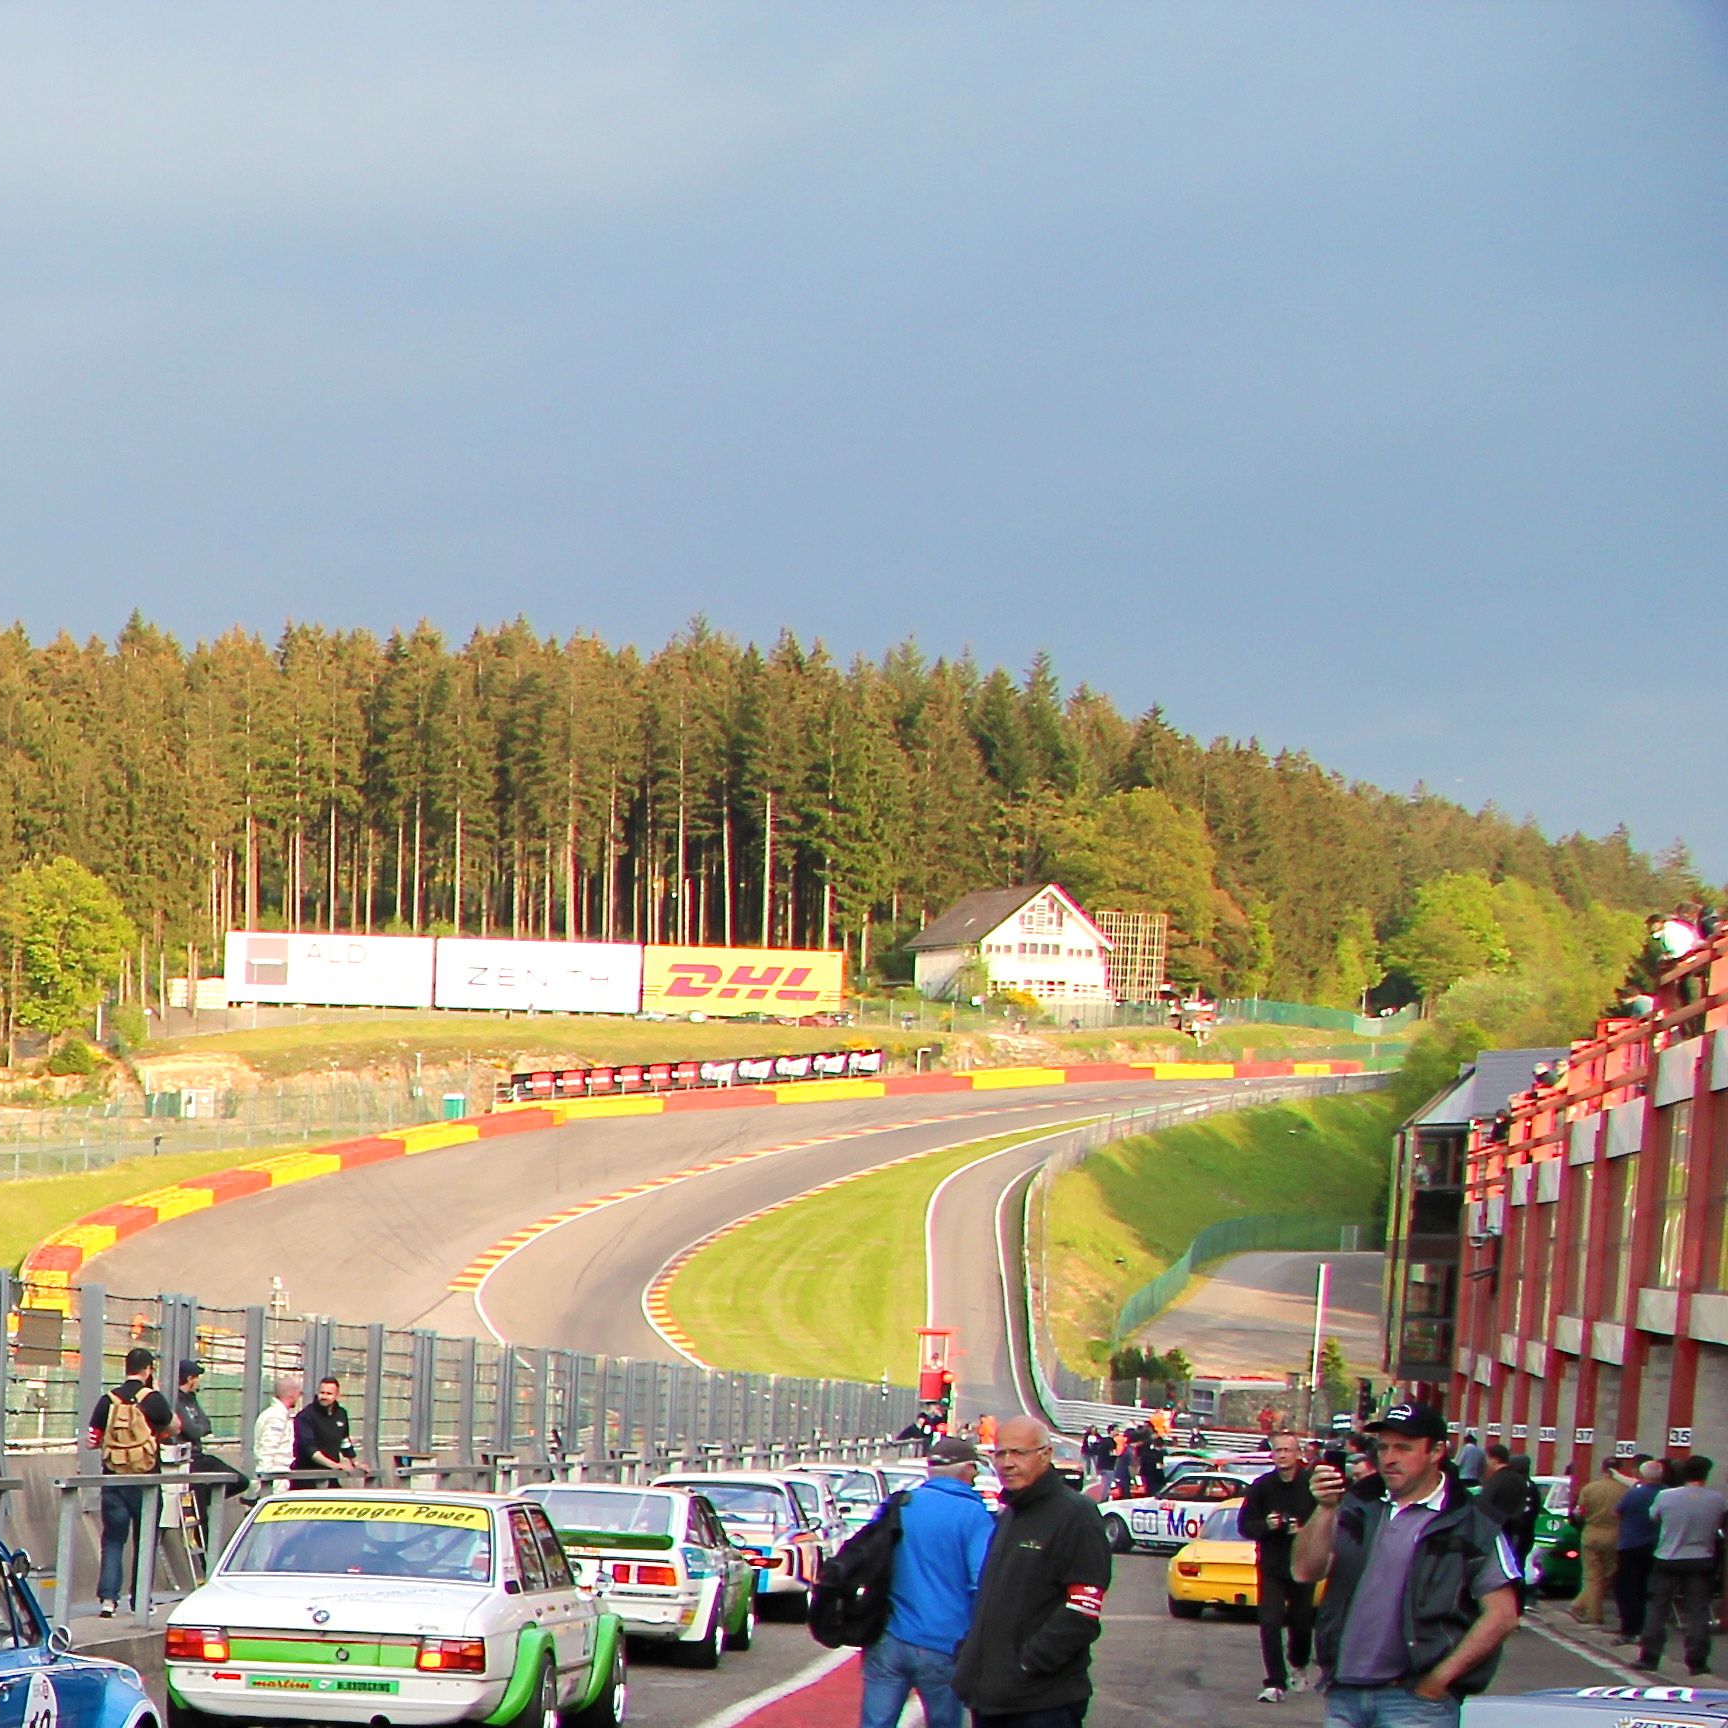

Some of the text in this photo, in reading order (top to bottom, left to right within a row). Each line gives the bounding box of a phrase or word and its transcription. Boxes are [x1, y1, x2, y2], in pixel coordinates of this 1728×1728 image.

[305, 943, 367, 964] ALD
[467, 966, 609, 987] ZENTH
[664, 963, 820, 1001] DHL
[1513, 1425, 1527, 1437] 39
[1541, 1428, 1556, 1440] 38
[1576, 1430, 1593, 1441] 37
[1670, 1429, 1690, 1443] 35
[1617, 1443, 1634, 1456] 36
[272, 1503, 476, 1523] Emmenegger Power
